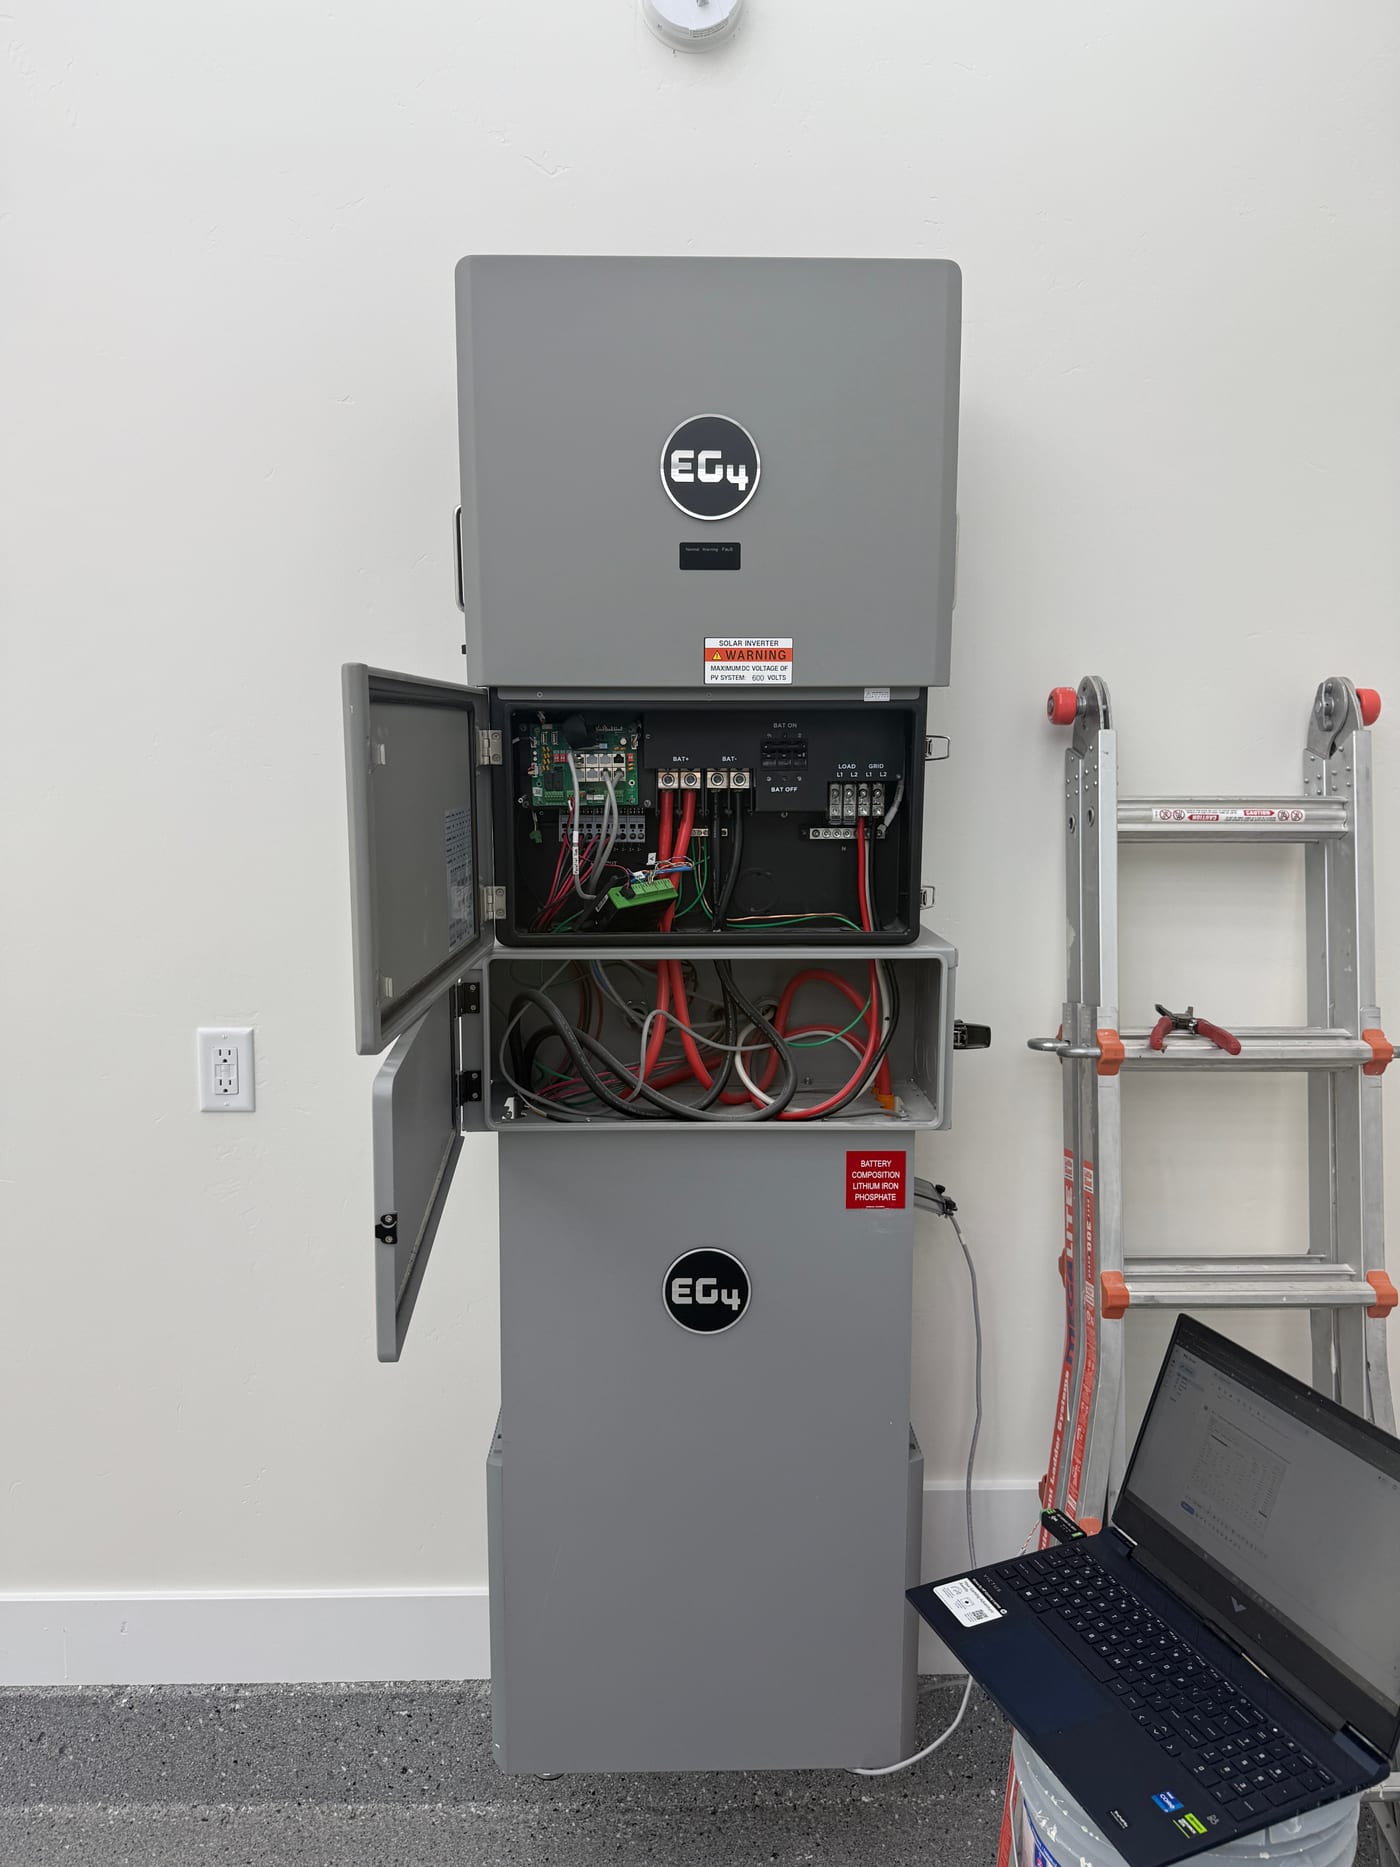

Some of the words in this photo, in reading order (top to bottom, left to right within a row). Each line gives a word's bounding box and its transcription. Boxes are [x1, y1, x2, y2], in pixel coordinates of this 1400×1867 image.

[670, 449, 749, 491] EG4
[725, 650, 786, 660] WARNING
[860, 1160, 892, 1168] BATTERY
[671, 1277, 741, 1311] EG4
